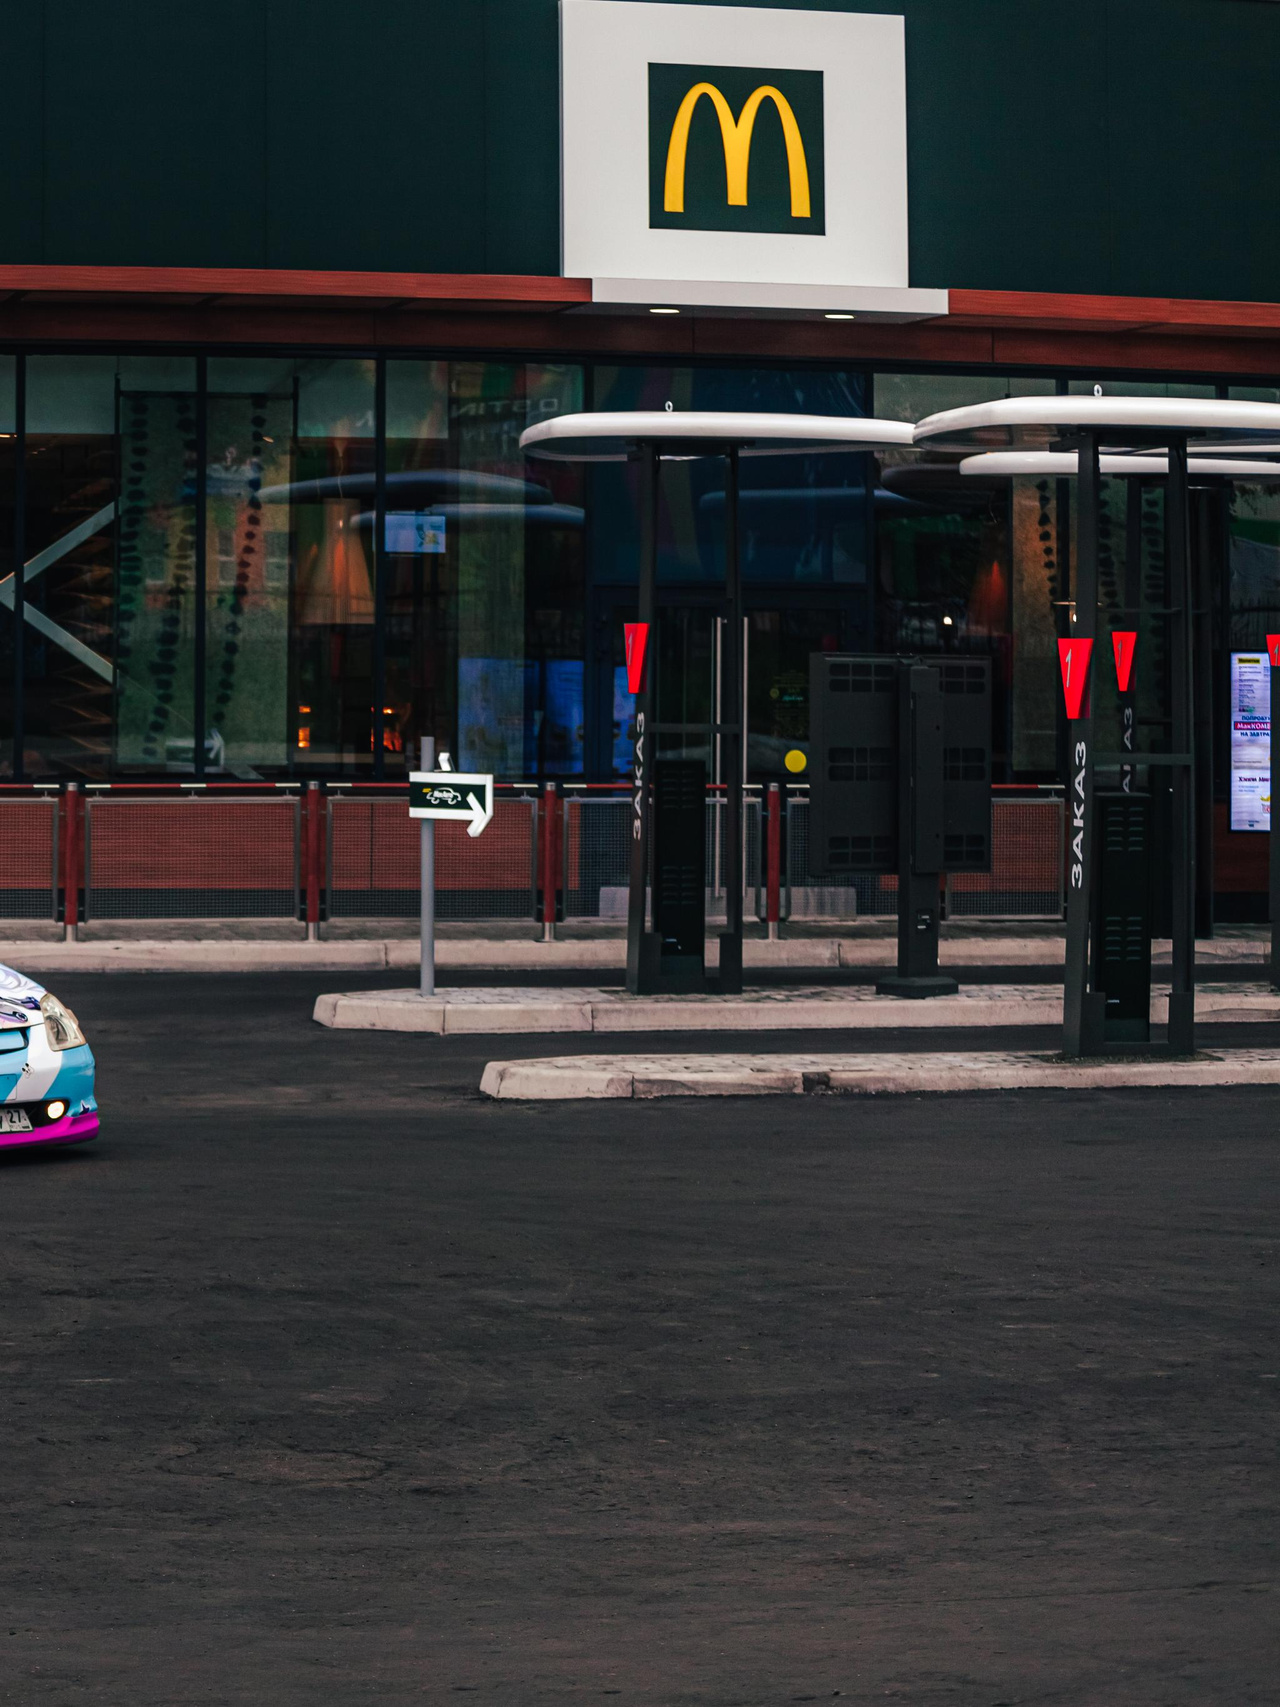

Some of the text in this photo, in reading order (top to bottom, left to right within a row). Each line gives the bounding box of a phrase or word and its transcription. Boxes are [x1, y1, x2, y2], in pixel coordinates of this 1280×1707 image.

[633, 711, 645, 841] ЗАКАЗ
[1071, 741, 1087, 889] ЗАКАЗ
[1122, 707, 1133, 793] ААЗ
